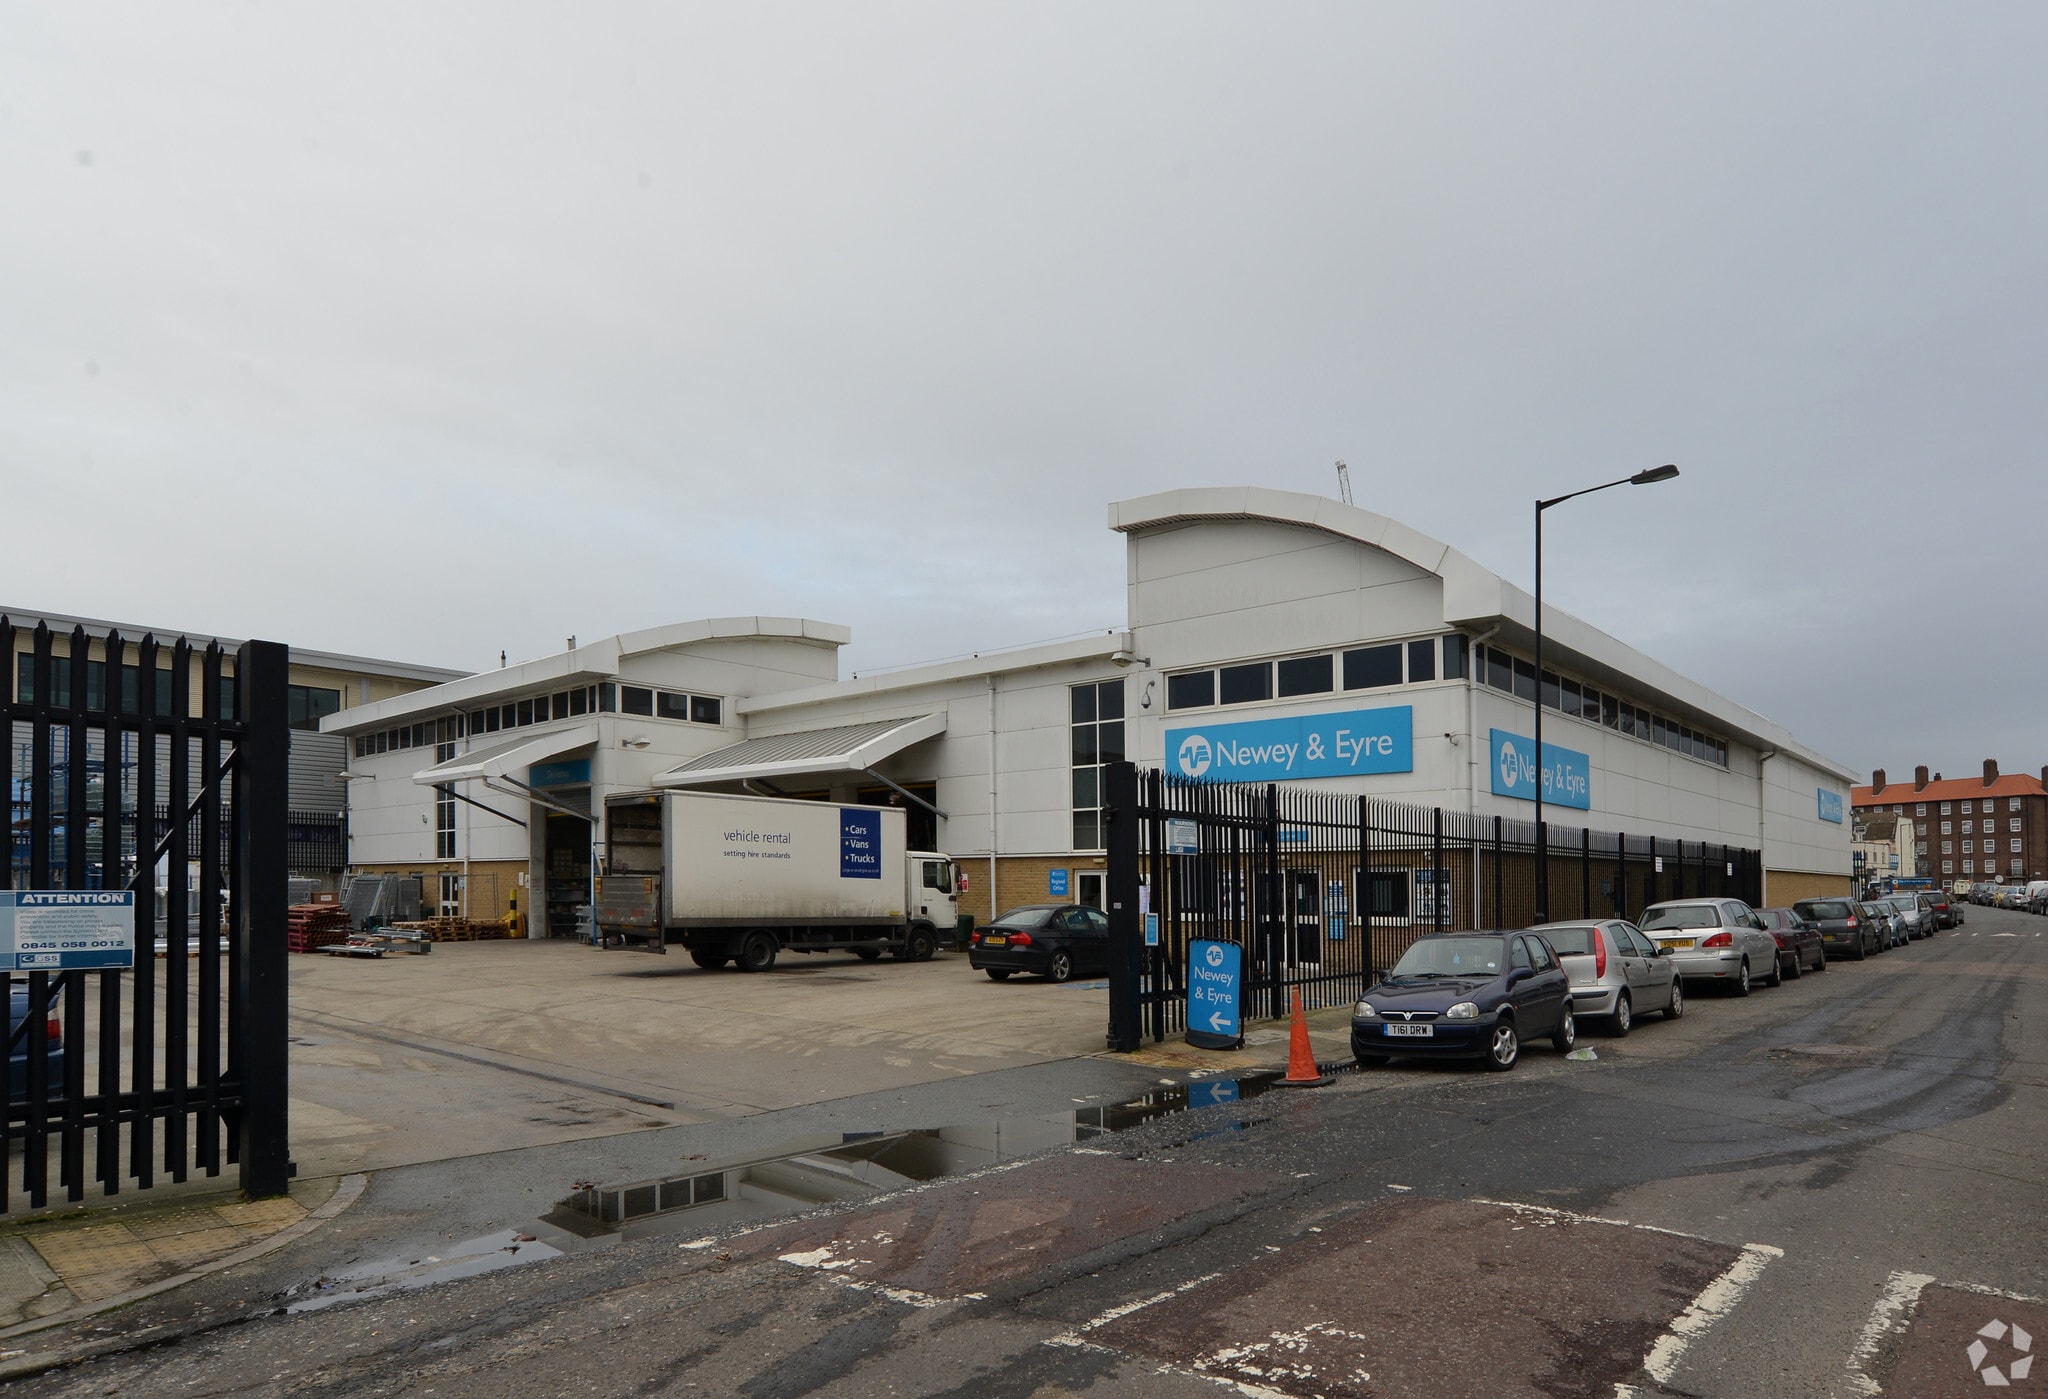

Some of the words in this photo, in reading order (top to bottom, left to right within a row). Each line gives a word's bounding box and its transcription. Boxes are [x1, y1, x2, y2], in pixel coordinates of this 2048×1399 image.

[1217, 740, 1299, 771] Newey
[1306, 732, 1326, 761] &
[1336, 729, 1393, 767] Eyre
[1556, 763, 1564, 790] &
[1566, 765, 1585, 800] Eyre
[850, 825, 867, 835] Cars
[723, 828, 760, 843] vehicle
[762, 832, 792, 844] rental
[850, 839, 870, 849] Vans
[723, 850, 746, 859] setting
[747, 850, 760, 859] hire
[761, 851, 791, 860] standards
[850, 853, 875, 864] Trucks
[22, 894, 125, 904] ATTENTION
[1194, 966, 1234, 988] Newey
[1195, 986, 1204, 1000] &
[1207, 987, 1232, 1006] Eyre
[1392, 1025, 1408, 1035] T161
[1410, 1025, 1428, 1035] DRW
